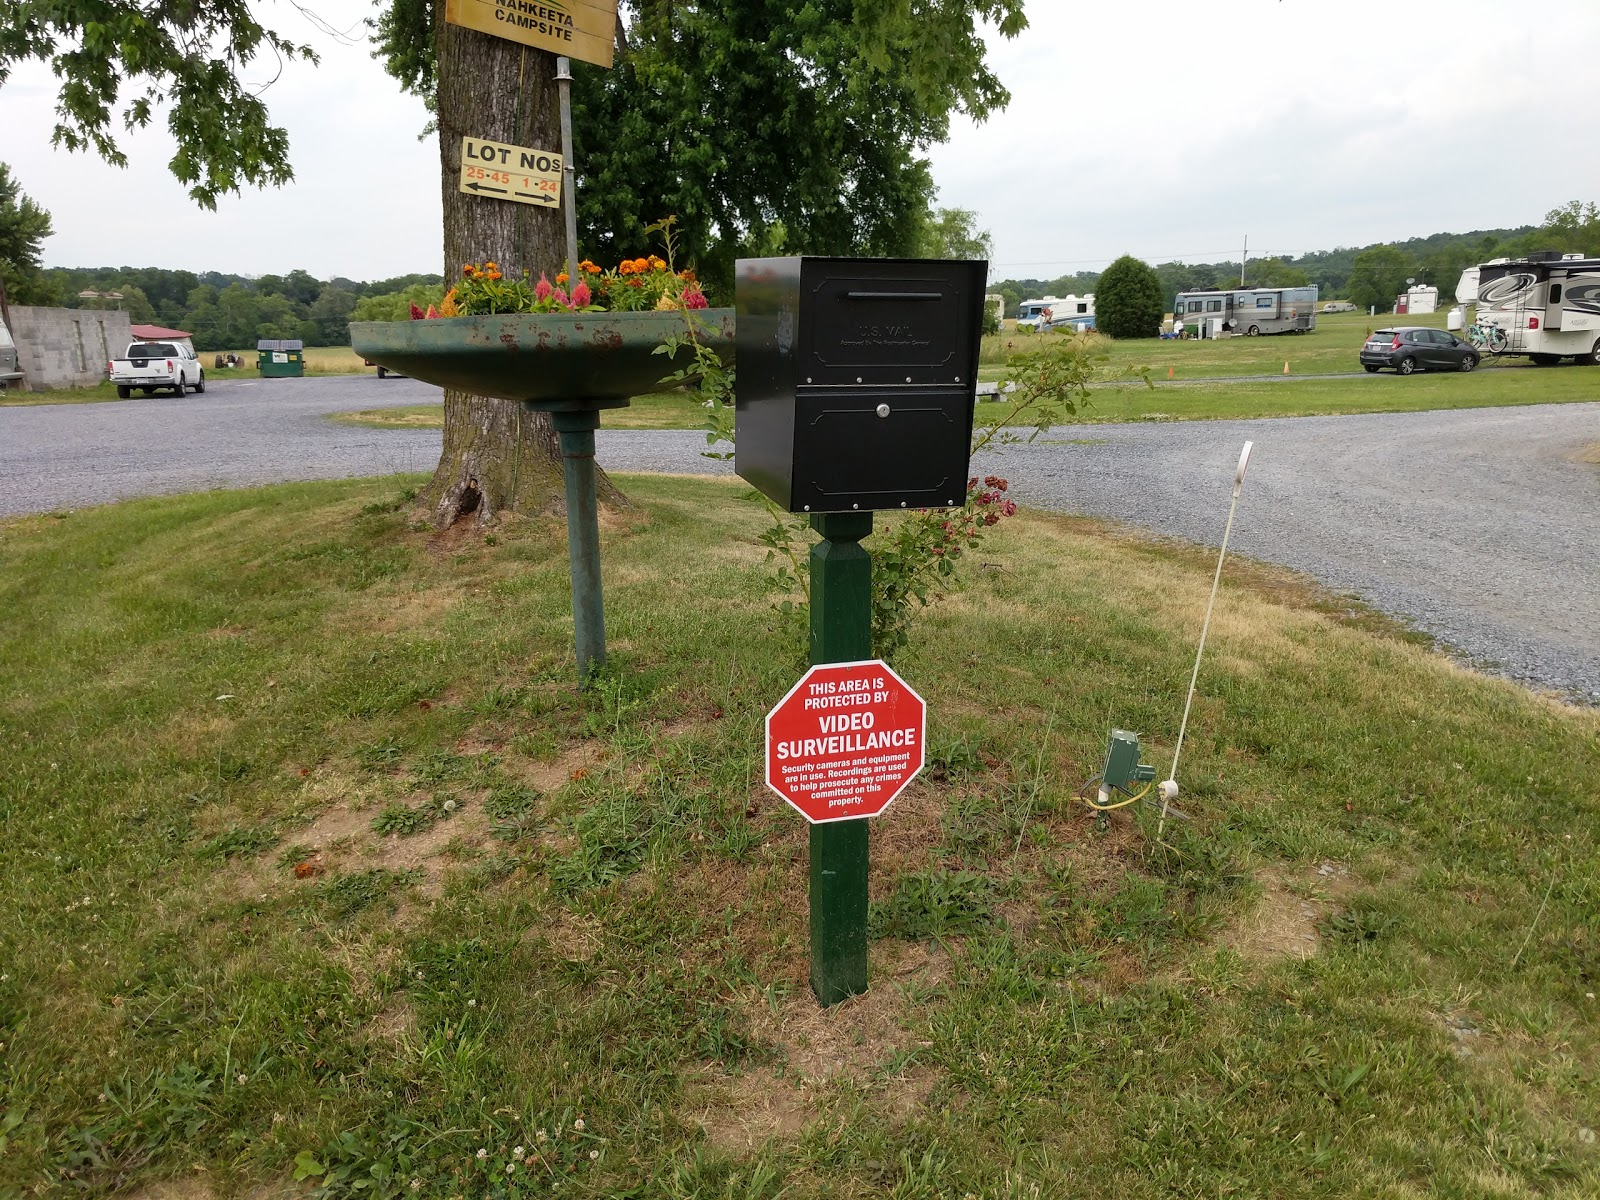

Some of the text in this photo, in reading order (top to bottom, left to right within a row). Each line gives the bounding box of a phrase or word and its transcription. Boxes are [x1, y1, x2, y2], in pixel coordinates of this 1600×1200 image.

[495, 9, 573, 42] CAMPSITE
[467, 142, 511, 164] LOT
[467, 166, 510, 184] 25-45
[809, 677, 884, 695] THIS AREA IS
[804, 691, 889, 710] PROTECTED BY
[818, 711, 875, 734] VIDEO
[776, 728, 916, 759] SURVEILLANCE
[781, 752, 910, 774] Security cameras and equipment
[785, 775, 798, 783] are
[800, 773, 808, 781] in
[809, 771, 826, 780] use.
[828, 766, 872, 778] Recordings
[888, 762, 907, 770] used
[790, 772, 902, 792] to help prosecute any crimes
[811, 783, 881, 799] committed on this
[828, 795, 864, 808] property.
